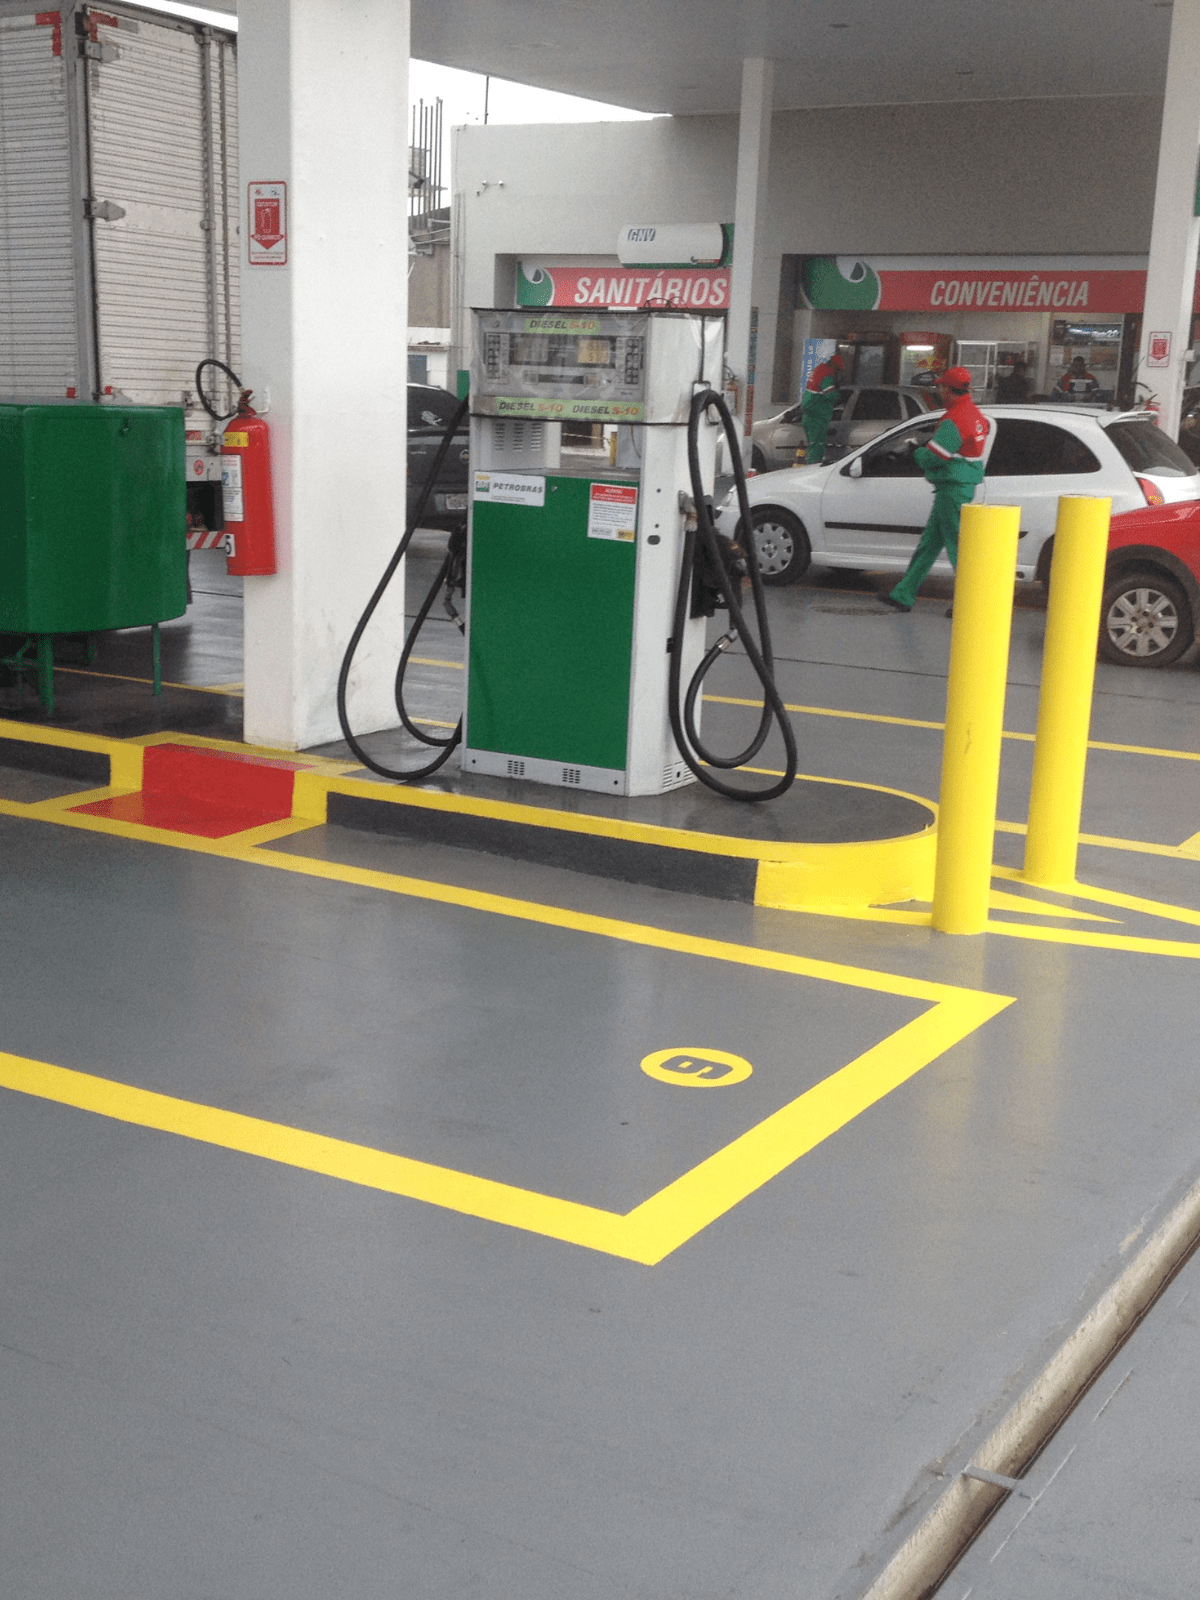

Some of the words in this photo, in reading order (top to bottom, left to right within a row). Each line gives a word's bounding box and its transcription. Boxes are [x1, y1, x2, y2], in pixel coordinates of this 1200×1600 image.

[628, 228, 656, 242] GNV
[574, 271, 728, 305] SANITÁRIOS
[930, 275, 1089, 307] CONVENIÊNCIA
[529, 319, 567, 329] DIESEL
[499, 402, 535, 411] DIESEL
[572, 405, 610, 415] DIESEL
[493, 482, 543, 494] PETROBRAS
